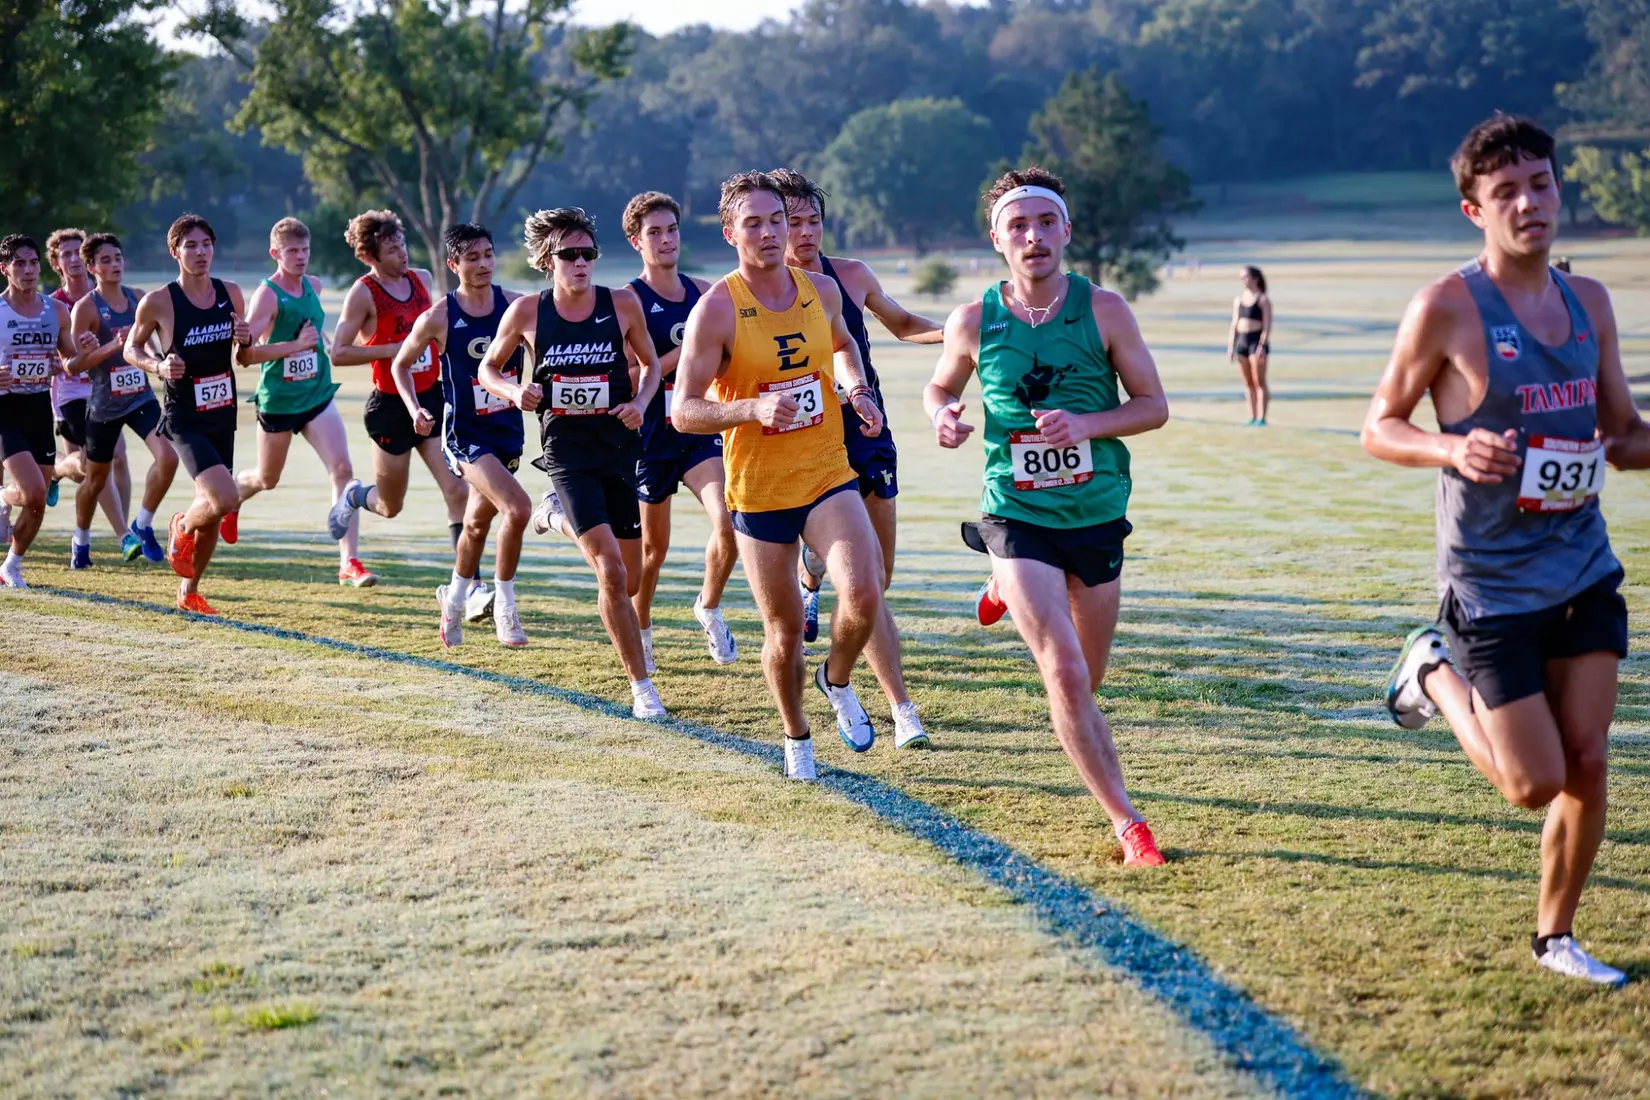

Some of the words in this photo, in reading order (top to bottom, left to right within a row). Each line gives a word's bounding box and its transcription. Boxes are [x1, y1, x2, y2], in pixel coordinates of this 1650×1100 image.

[187, 321, 232, 336] ALABAMA
[12, 332, 52, 345] SCAD
[545, 342, 612, 356] ALABAMA
[773, 332, 810, 371] E
[289, 357, 313, 373] 803
[541, 352, 617, 367] HUNTSVILLE
[17, 363, 45, 376] 876
[116, 372, 141, 388] 935
[201, 383, 227, 401] 573
[560, 388, 601, 405] 567
[1023, 445, 1080, 475] 806
[1537, 458, 1598, 491] 931
